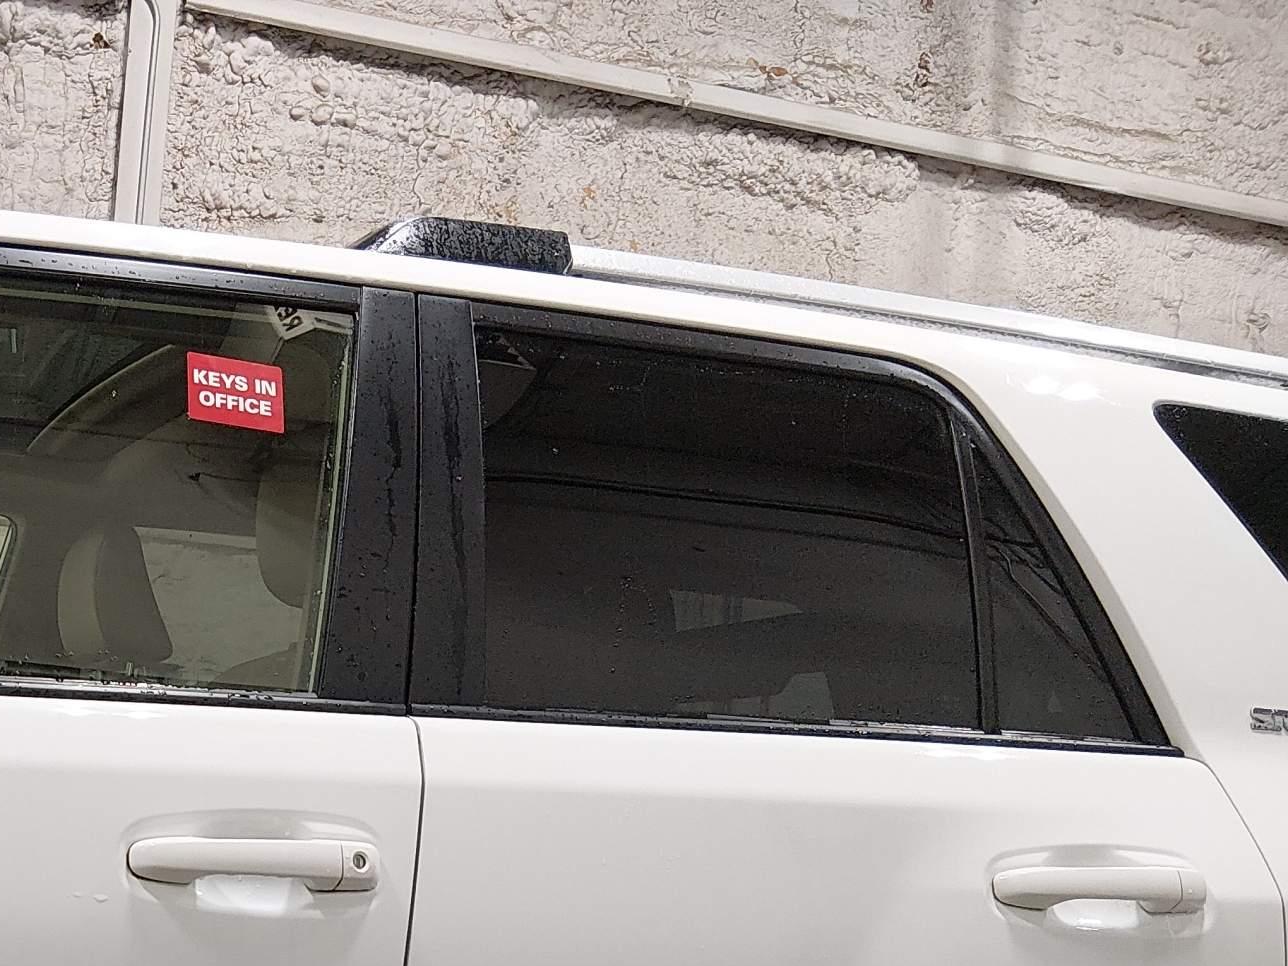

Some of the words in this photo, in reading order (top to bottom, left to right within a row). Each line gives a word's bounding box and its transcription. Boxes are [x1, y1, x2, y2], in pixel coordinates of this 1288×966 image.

[193, 368, 249, 392] KEYS
[254, 378, 277, 397] IN
[198, 390, 272, 417] OFFICE
